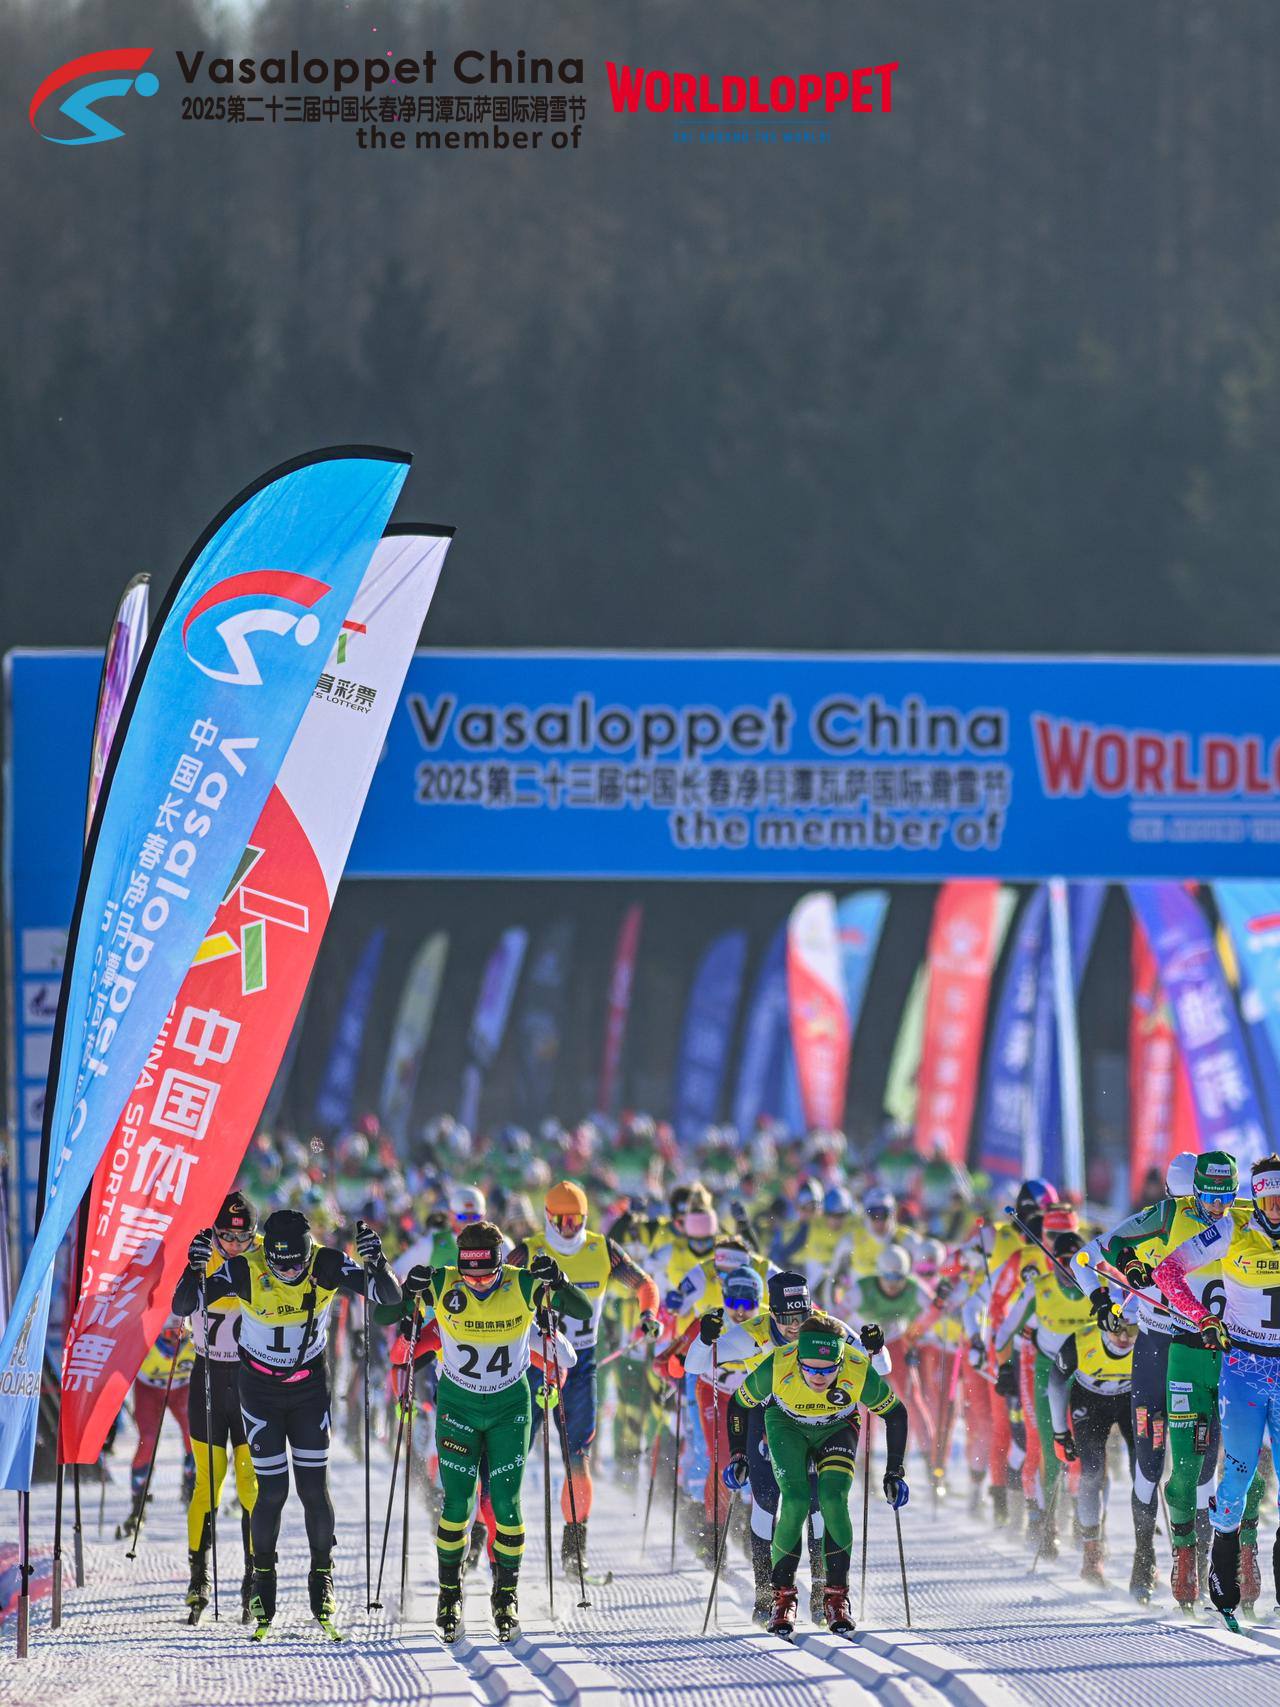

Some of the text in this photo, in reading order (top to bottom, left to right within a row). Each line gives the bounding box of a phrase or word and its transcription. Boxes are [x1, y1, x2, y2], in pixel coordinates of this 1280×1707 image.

[326, 695, 371, 714] LOTTERY
[409, 695, 1004, 758] Vasaloppet China
[672, 812, 1002, 849] the member of
[89, 737, 260, 1078] Vasaloppet
[96, 1102, 145, 1240] SPORTS
[449, 1296, 461, 1311] 4
[811, 1339, 831, 1347] SWECO
[456, 1343, 513, 1380] 24
[479, 1383, 497, 1392] JILIN
[833, 1392, 844, 1404] 2
[443, 1440, 468, 1454] NTNUI
